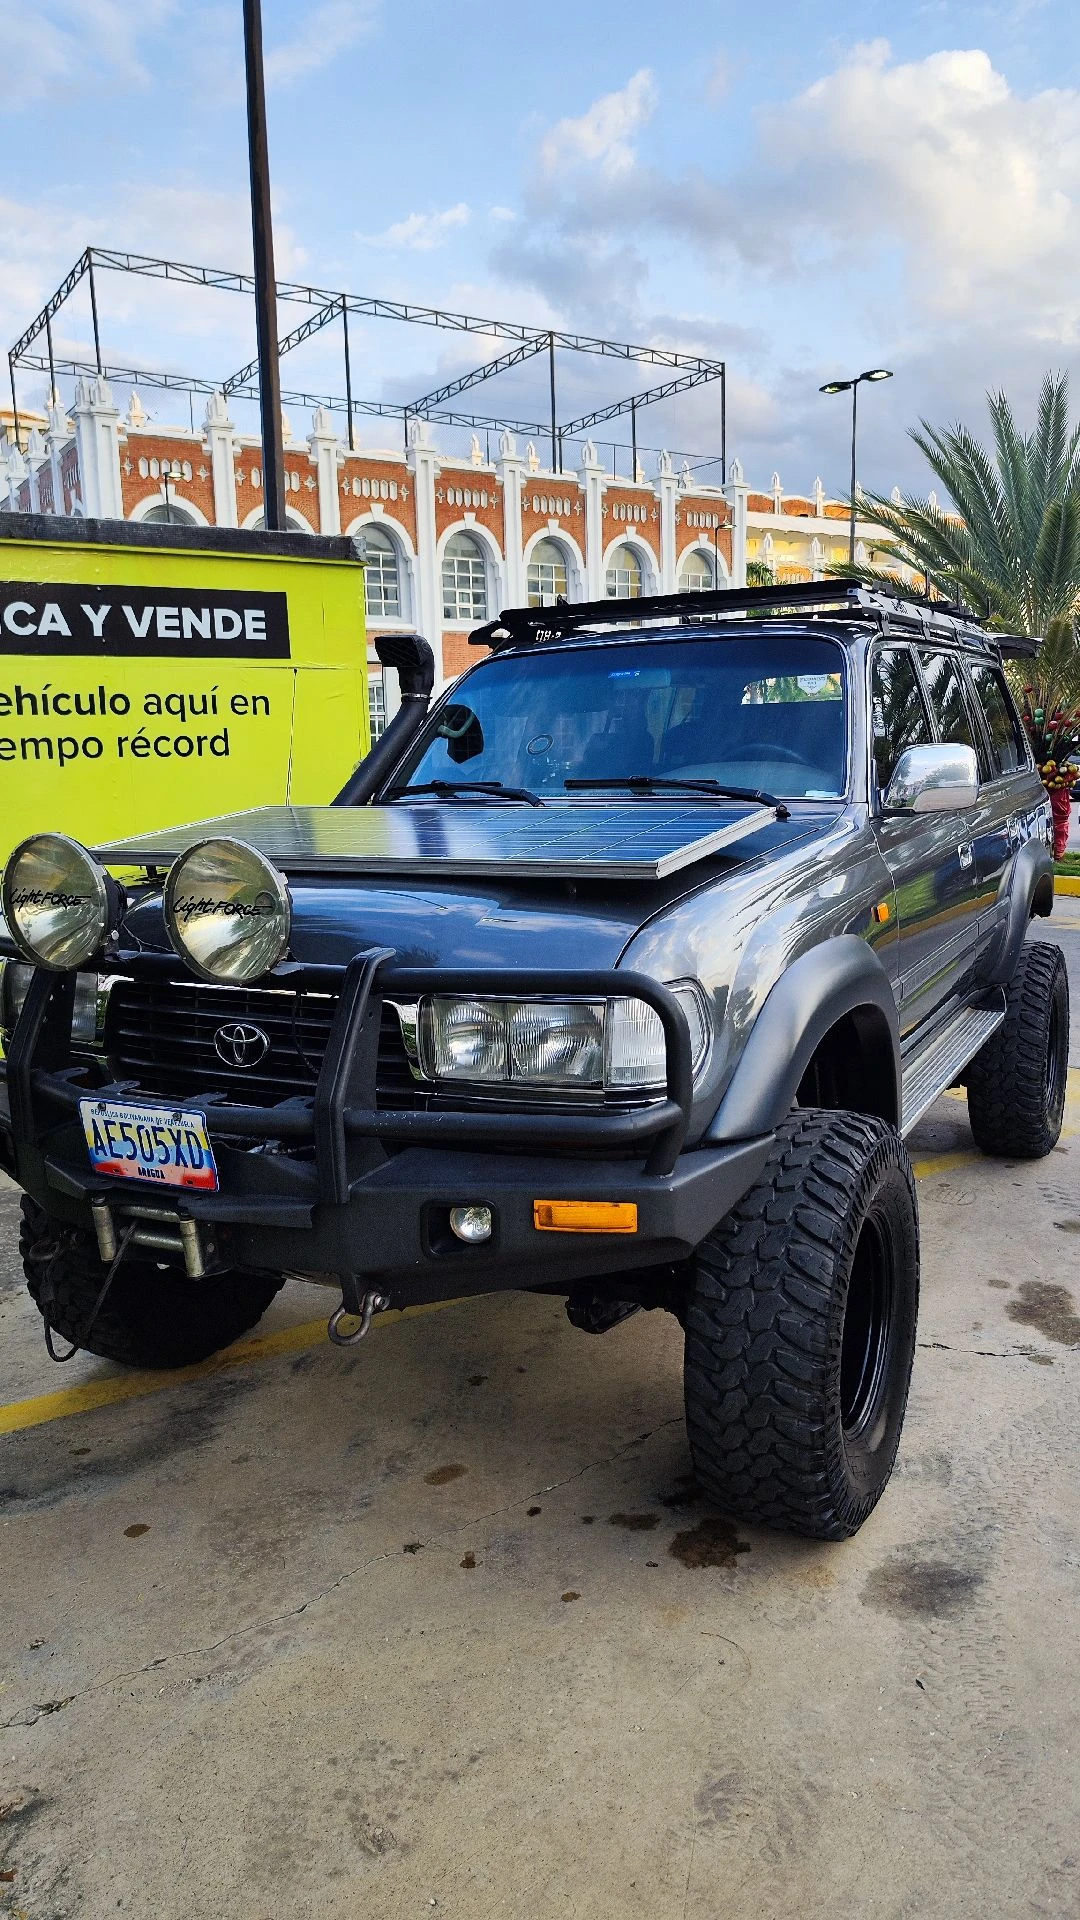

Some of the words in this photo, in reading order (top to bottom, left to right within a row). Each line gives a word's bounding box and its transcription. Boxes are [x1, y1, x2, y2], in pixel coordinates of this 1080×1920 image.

[80, 604, 113, 637] Y
[121, 605, 267, 641] VENDE
[0, 683, 131, 717] ehículo
[143, 685, 219, 723] aquí
[230, 694, 270, 716] en
[0, 736, 104, 768] empo
[117, 726, 230, 758] récord
[91, 1118, 205, 1170] AE505XD
